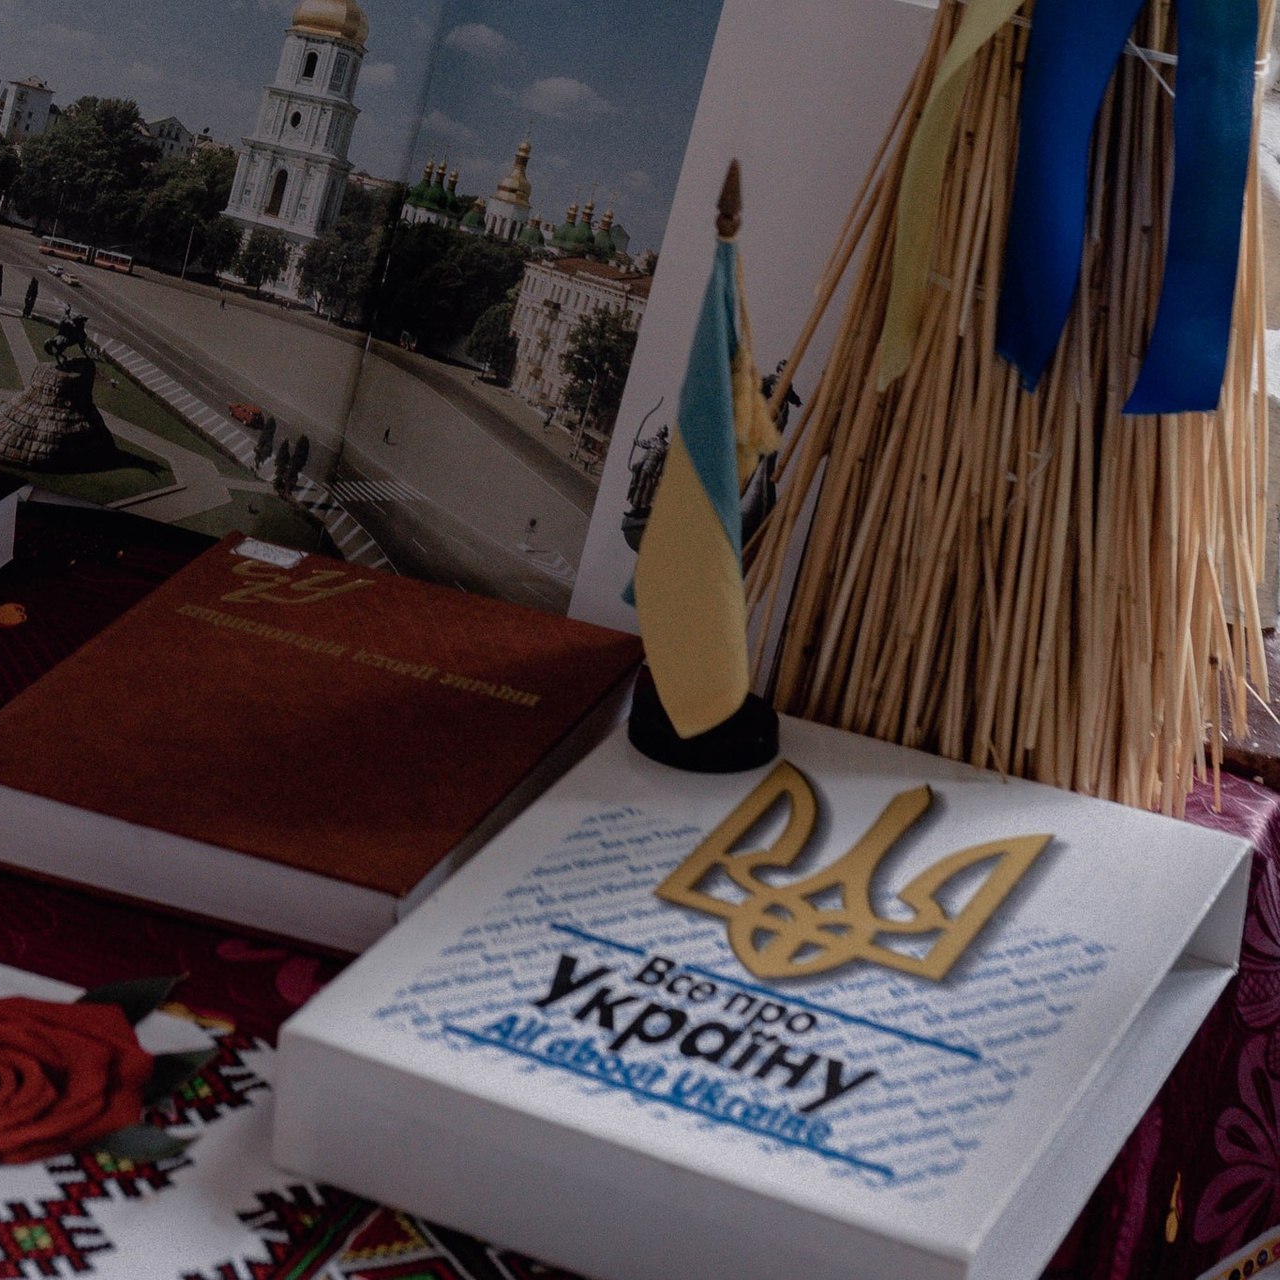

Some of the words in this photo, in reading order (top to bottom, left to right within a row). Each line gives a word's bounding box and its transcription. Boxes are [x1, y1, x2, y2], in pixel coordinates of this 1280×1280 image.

[532, 953, 881, 1114] Україну
[635, 956, 717, 1003] Все
[723, 990, 818, 1034] про
[485, 1014, 548, 1048] All
[546, 1034, 667, 1086] about
